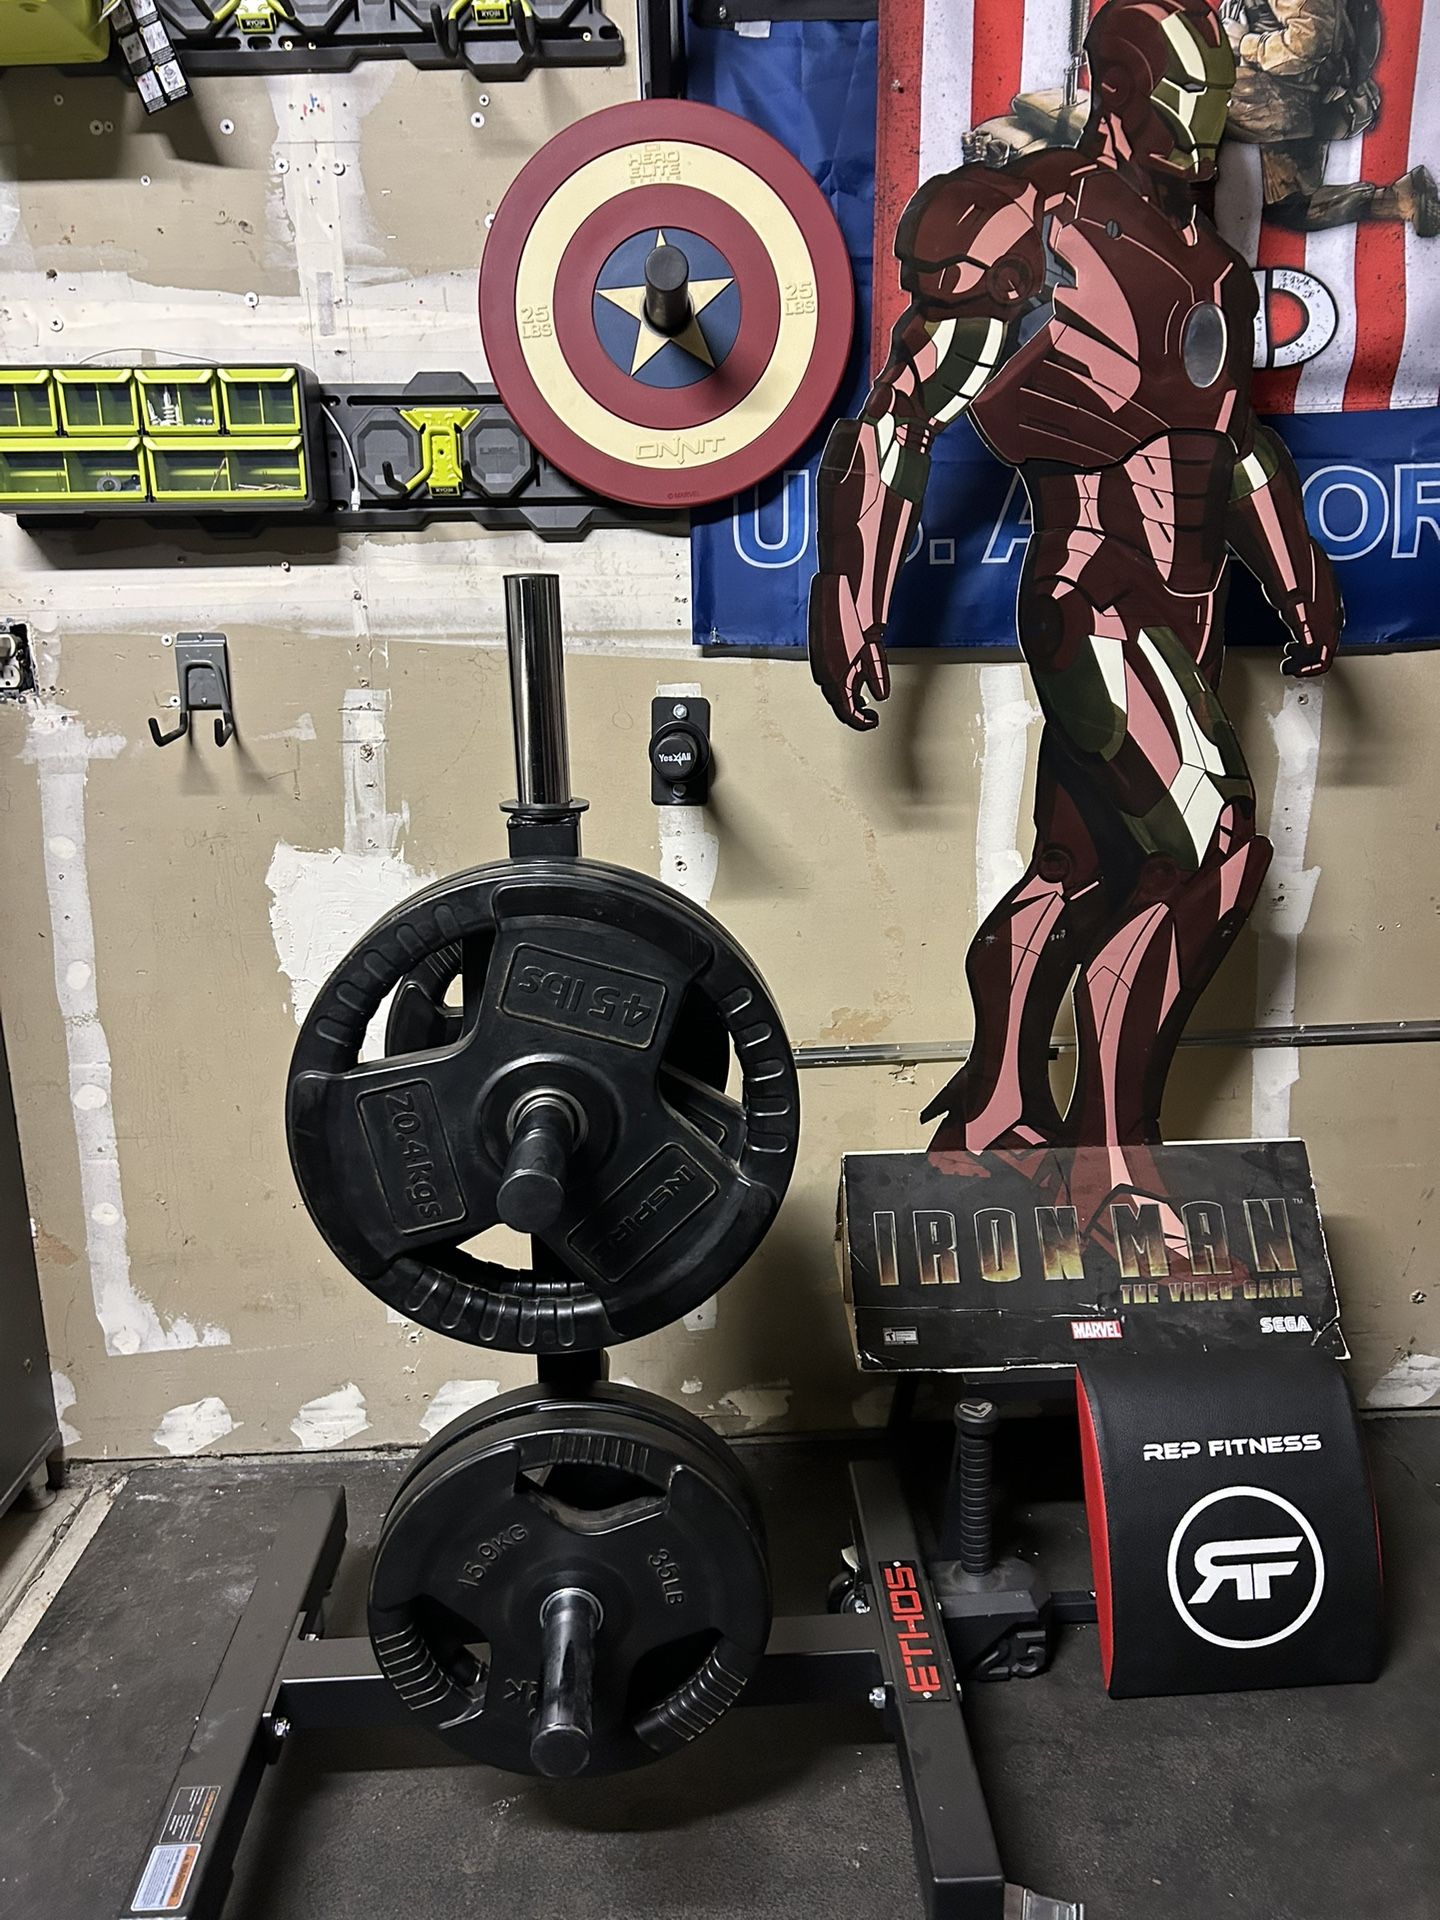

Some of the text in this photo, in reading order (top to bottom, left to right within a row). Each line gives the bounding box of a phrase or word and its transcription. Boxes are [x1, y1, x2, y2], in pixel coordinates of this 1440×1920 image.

[629, 150, 680, 166] HERO
[629, 163, 681, 178] ELITE
[785, 281, 813, 300] 25
[521, 305, 550, 324] 25
[785, 300, 816, 316] LBS
[522, 323, 553, 339] LBS
[636, 436, 726, 465] ONNIT
[518, 965, 652, 1027] 45 lbs
[873, 1206, 1085, 1286] IRON
[1110, 1198, 1298, 1278] MAN
[1120, 1277, 1303, 1304] THE VIDEO GAME
[1073, 1321, 1122, 1339] MARVEL
[1260, 1315, 1313, 1333] SEGA
[1143, 1434, 1322, 1461] REP FITNESS
[458, 1524, 528, 1587] 15.9KG
[648, 1548, 684, 1605] 35LB
[884, 1567, 941, 1692] ETHOS
